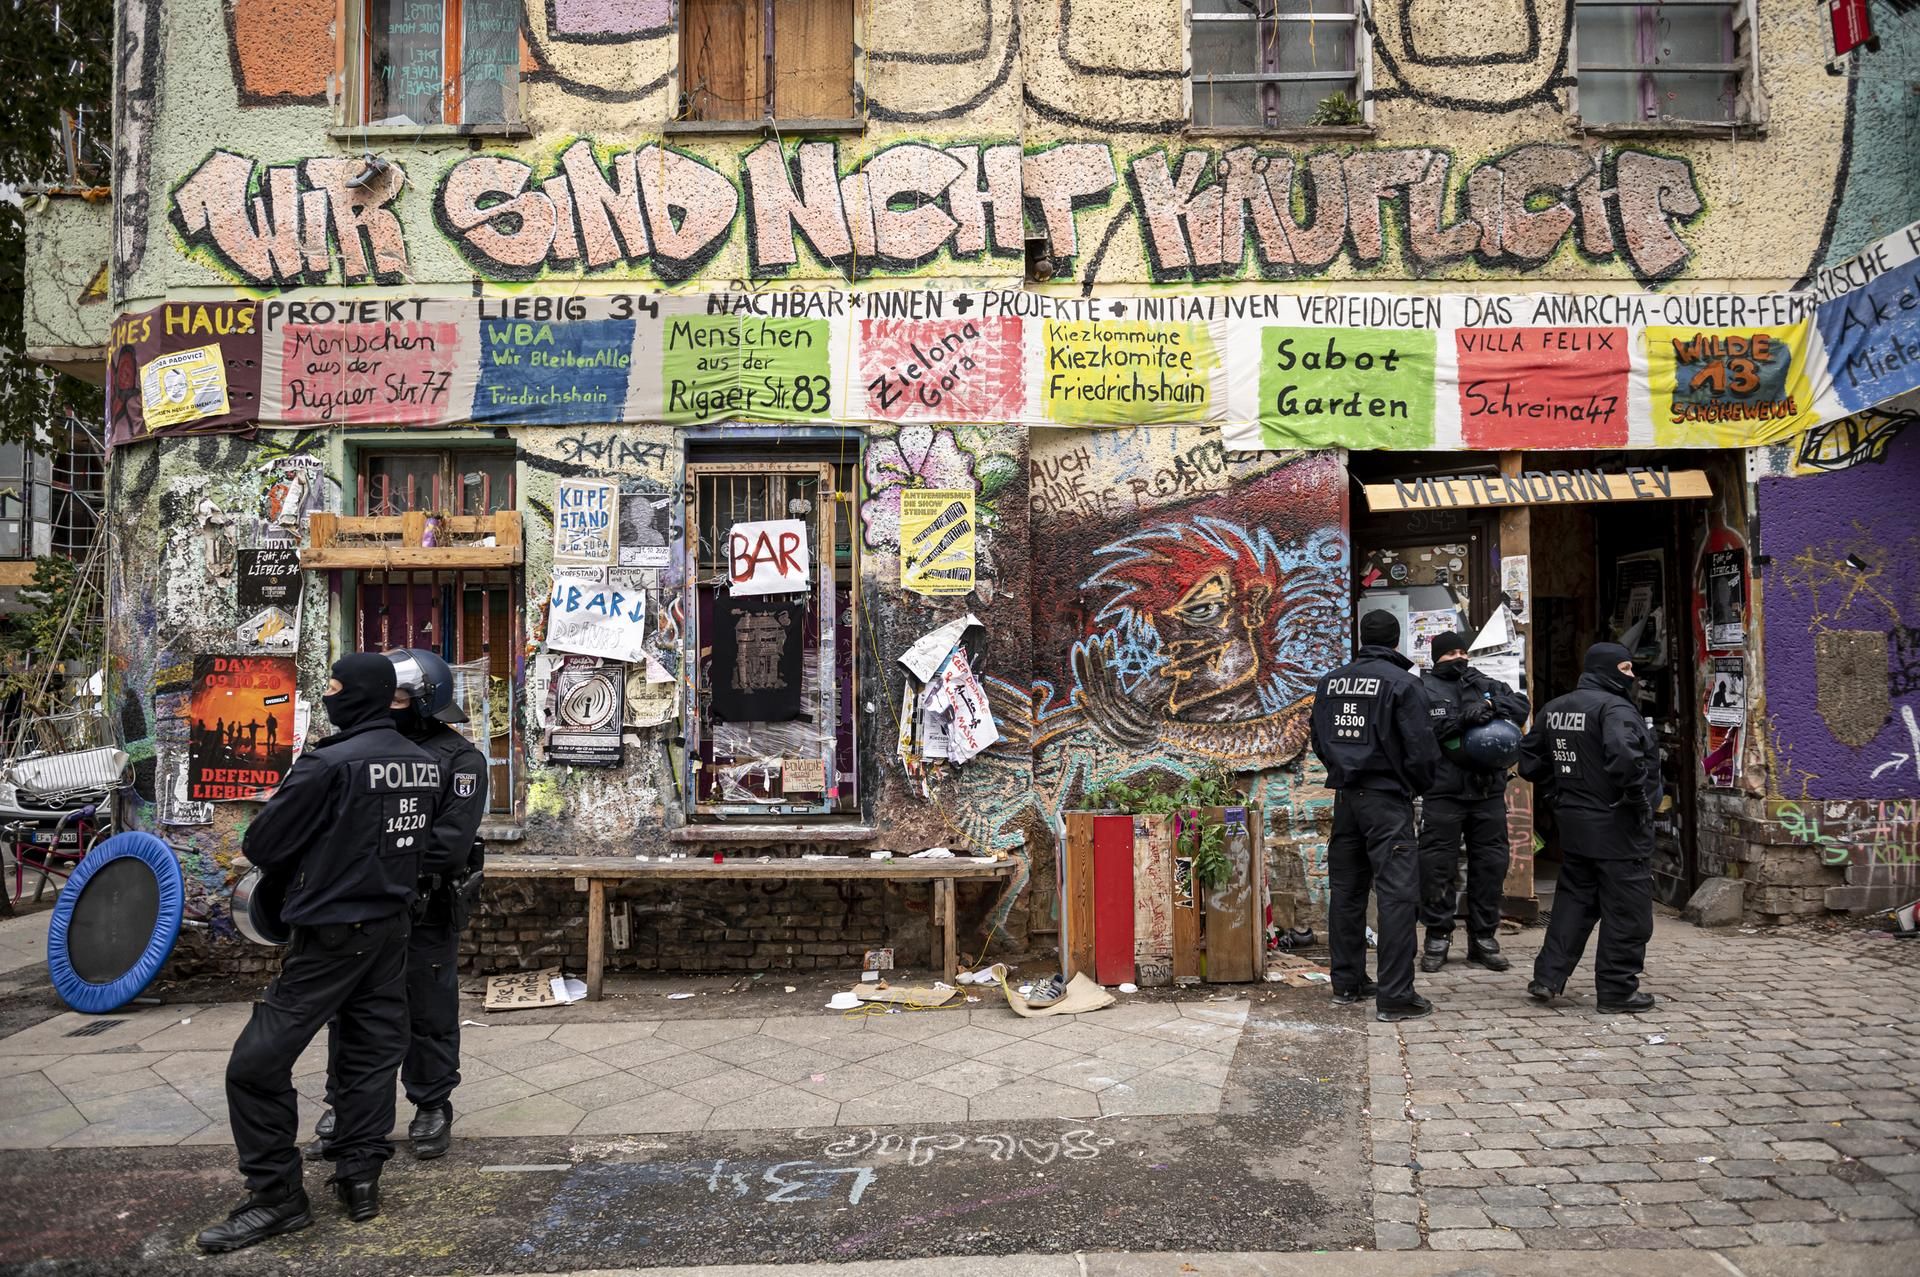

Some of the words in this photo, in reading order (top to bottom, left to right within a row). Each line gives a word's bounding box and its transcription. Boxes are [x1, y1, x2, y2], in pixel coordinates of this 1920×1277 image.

[168, 147, 412, 288] WIR
[433, 138, 740, 284] SIND
[742, 138, 1117, 282] NICHT
[165, 305, 256, 335] HAUS
[267, 298, 429, 331] PROJEKT
[478, 296, 587, 321] LIEBIG
[609, 294, 659, 320] 34
[982, 290, 1100, 322] PROJEKTE
[1137, 294, 1279, 322] INITIATIVEN
[1297, 296, 1441, 329] VERTEIDIGEN
[1464, 296, 1512, 327] DAS
[292, 328, 436, 359] Menschen
[487, 322, 556, 347] WBA
[669, 322, 814, 350] Menschen
[1048, 324, 1181, 345] Kiezkommune
[1461, 332, 1524, 353] VILLA
[1543, 331, 1614, 351] FELIX
[168, 352, 203, 364] PADOVICZ
[492, 349, 523, 367] Wir
[1049, 345, 1193, 371] Kiezkomitee
[1277, 336, 1401, 372] Sabot
[1672, 332, 1771, 365] WILDE
[307, 361, 341, 374] aus
[347, 357, 382, 374] der
[696, 354, 729, 371] aus
[742, 354, 774, 371] der
[867, 321, 982, 411] Zielona
[918, 354, 977, 409] Gora
[1049, 373, 1206, 404] Friedrichshain
[1690, 358, 1761, 398] 13
[287, 379, 377, 419] Rigaer
[487, 384, 608, 406] Friedrichshain
[669, 379, 756, 420] Rigaer
[1276, 385, 1408, 419] Garden
[1030, 446, 1091, 488] AUCH
[1394, 468, 1613, 508] MITTENDRIN
[1625, 465, 1672, 499] EV
[560, 487, 610, 510] KOPF
[561, 511, 609, 528] STAND
[583, 540, 609, 550] SUPA
[257, 551, 276, 562] Fight
[280, 551, 291, 560] for
[729, 530, 803, 584] BAR
[248, 564, 285, 576] LIEBIG
[286, 564, 299, 576] 34
[560, 570, 598, 578] KOPFSTAND
[566, 585, 625, 618] BAR
[214, 658, 254, 672] DAY
[260, 659, 273, 672] X
[205, 674, 281, 689] 09.10.20
[1326, 677, 1380, 696] POLIZEI
[1343, 703, 1357, 714] BE
[957, 715, 979, 749] MASKS
[1334, 715, 1365, 727] 36300
[1547, 712, 1586, 731] POLIZEI
[1556, 739, 1567, 750] BE
[1553, 750, 1577, 762] 36310
[201, 768, 279, 784] DEFEND
[369, 762, 440, 789] POLIZEI
[193, 784, 257, 799] LIEBIG
[400, 797, 418, 814] BE
[386, 814, 426, 832] 14220
